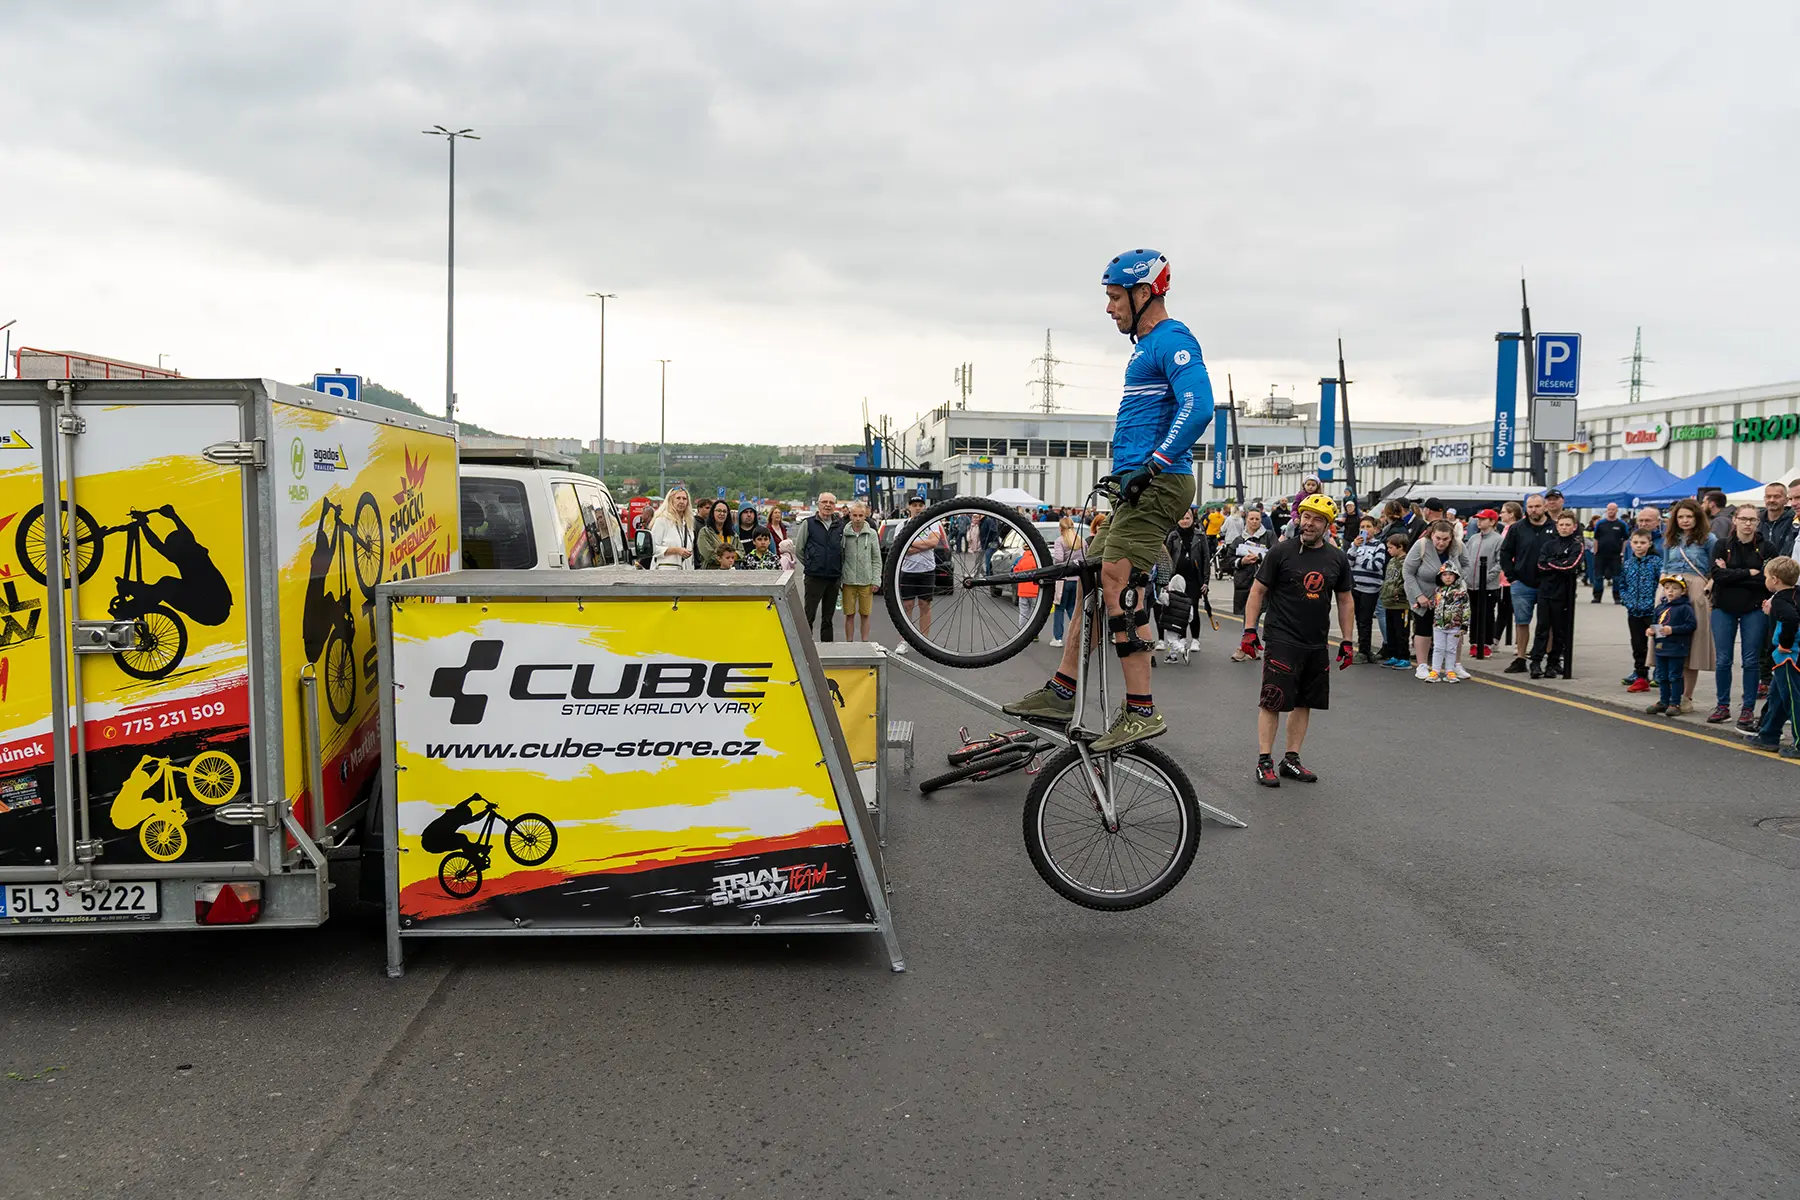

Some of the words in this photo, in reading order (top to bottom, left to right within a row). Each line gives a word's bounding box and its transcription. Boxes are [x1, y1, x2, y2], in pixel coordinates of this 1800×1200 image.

[1545, 341, 1571, 376] P
[1539, 379, 1574, 389] RÉSERVÉ
[1496, 411, 1508, 457] olympia
[1733, 413, 1800, 442] CROP
[314, 448, 339, 462] agados
[1430, 443, 1469, 458] FISCHER
[389, 492, 425, 543] SHOCK!
[389, 514, 437, 571] ADRENALIN
[509, 662, 774, 700] CUBE
[122, 717, 154, 736] 775
[158, 709, 187, 728] 231
[191, 701, 225, 721] 509
[561, 704, 620, 716] STORE
[623, 702, 709, 716] KARLOVY
[713, 702, 763, 715] VARY
[0, 742, 46, 764] ůnek
[426, 738, 761, 759] www.cube-store.cz
[712, 867, 788, 892] TRIAL
[777, 862, 828, 895] TEAM
[12, 887, 59, 912] 5L3
[81, 885, 145, 911] 5222
[711, 880, 788, 906] SHOW
